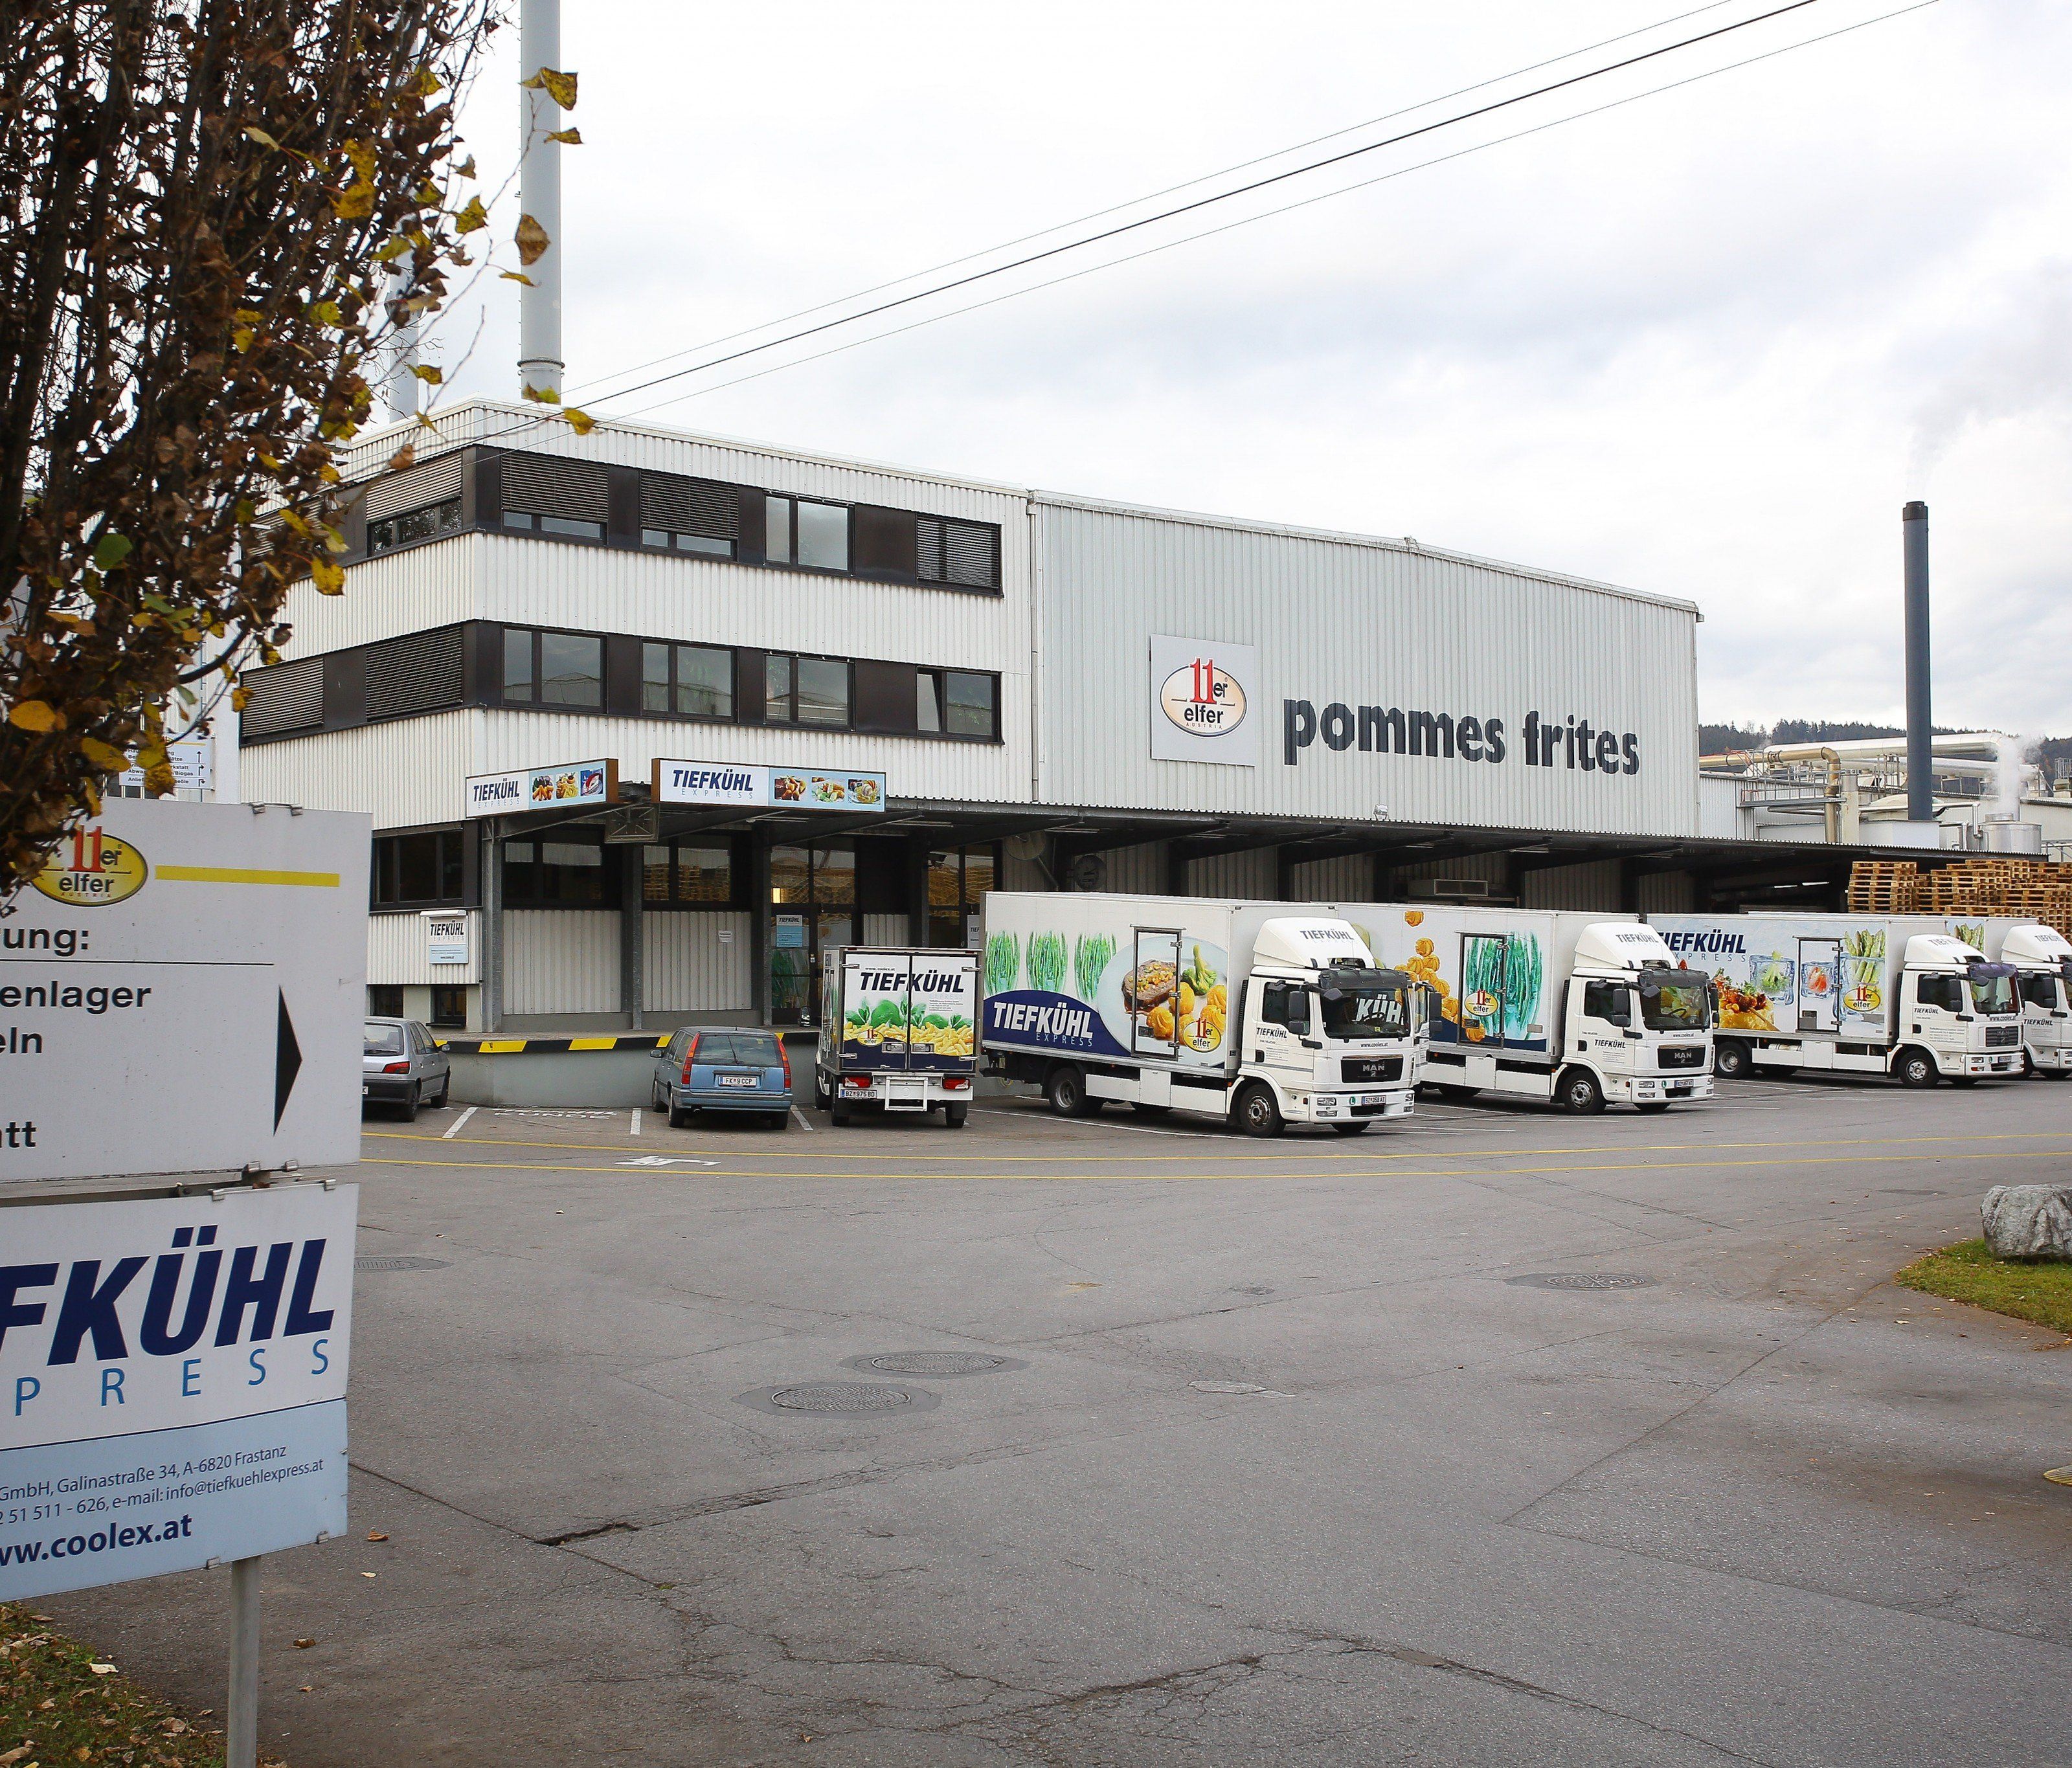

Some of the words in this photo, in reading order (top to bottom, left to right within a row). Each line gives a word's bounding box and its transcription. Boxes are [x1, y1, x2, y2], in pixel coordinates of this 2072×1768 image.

[1189, 658, 1228, 704] 11er
[1184, 704, 1224, 724] elfer
[1283, 699, 1506, 766] pommes
[1523, 711, 1639, 775] frites
[473, 778, 520, 802] TIEFKÜHL
[673, 768, 753, 792] TIEFKÜHL
[479, 798, 520, 809] EXPRESS
[681, 789, 753, 800] EXPRESS
[67, 825, 122, 873] 11er
[59, 873, 115, 893] elfer
[430, 920, 464, 936] TIEFKÜHL
[1300, 928, 1355, 940] TIEFKÜHL
[1616, 932, 1659, 943] TIEFKÜHL
[0, 928, 89, 957] ung:
[1674, 952, 1746, 963] XPRESS
[861, 970, 964, 992] TIEFKÜHL
[993, 1001, 1093, 1038] TIEFKÜHL
[1196, 1018, 1213, 1038] 11er
[1036, 1033, 1093, 1047] EXPRESS
[1193, 1038, 1210, 1047] elfer
[1257, 1027, 1287, 1038] TIEFKÜHL
[1595, 1039, 1626, 1048] TIEFKÜHL
[0, 1481, 54, 1501] GmbH,
[58, 1467, 155, 1493] Galinastraße
[158, 1464, 181, 1479] 34,
[183, 1454, 232, 1475] A-6820
[235, 1446, 287, 1466] Frastanz
[8, 1508, 26, 1524] 51
[33, 1503, 61, 1520] 511
[76, 1497, 109, 1514] 626,
[113, 1488, 164, 1508] e-mail:
[166, 1459, 324, 1501] info@tiefkuehlexpress.at
